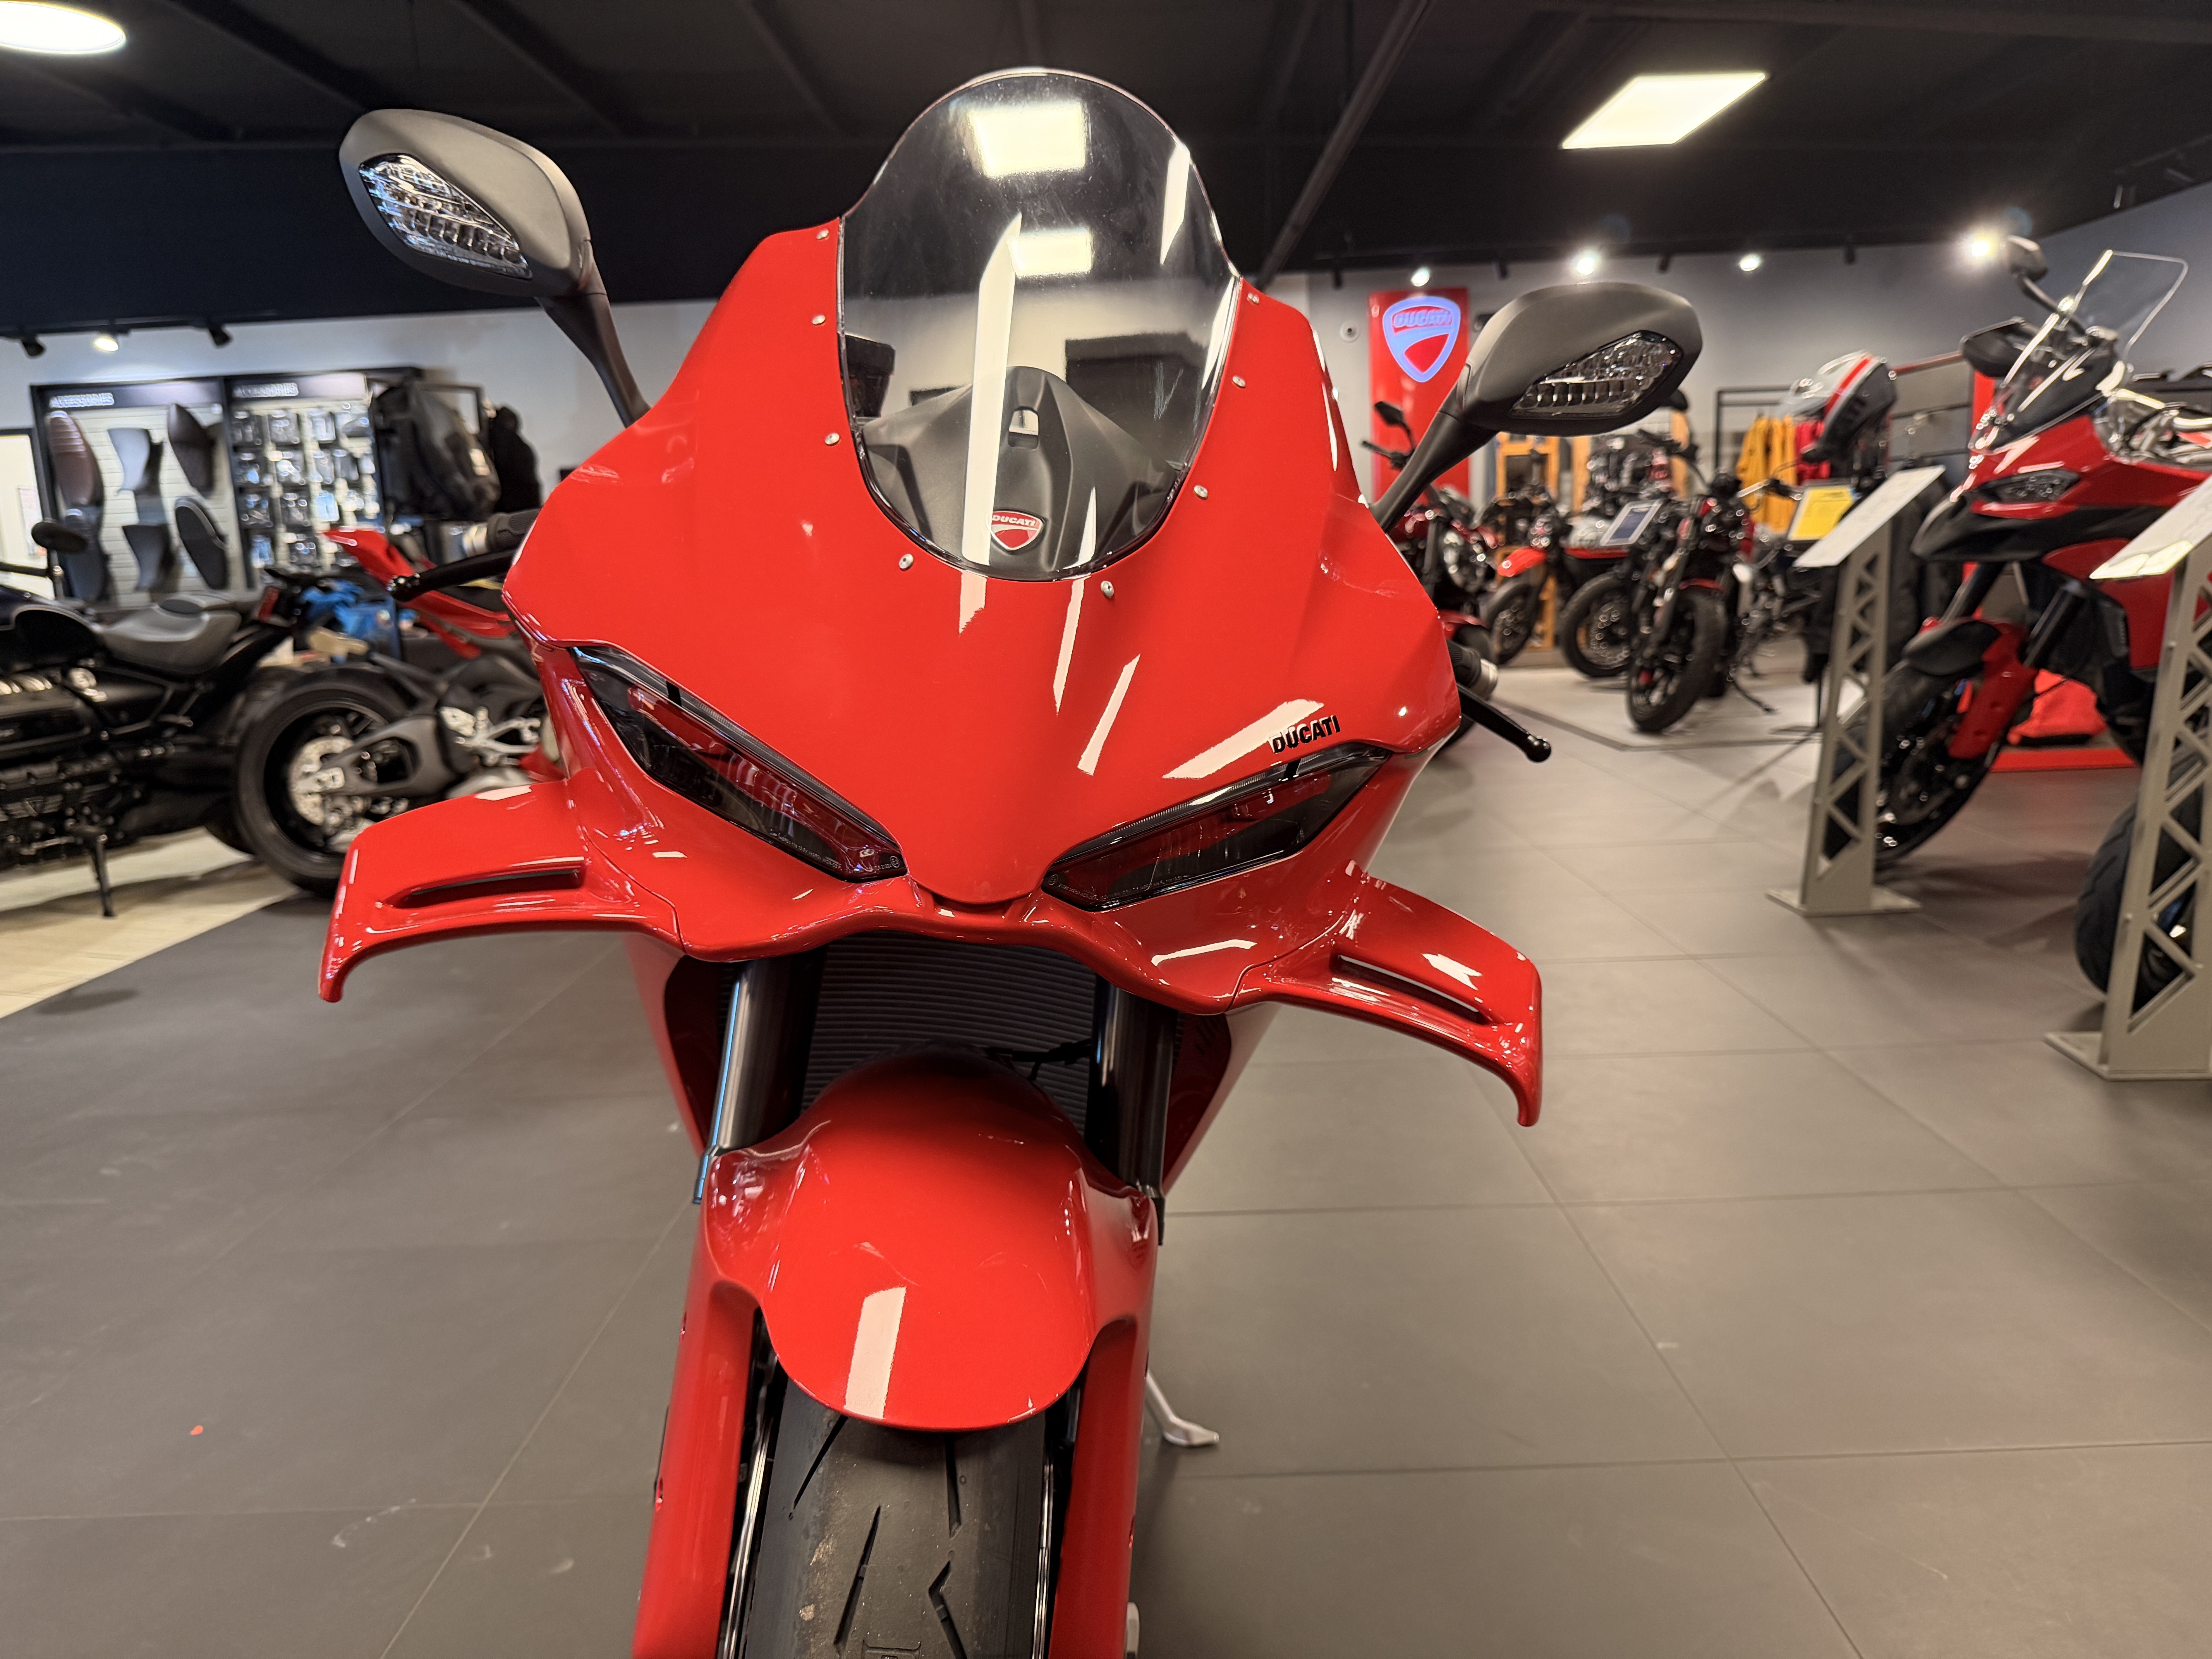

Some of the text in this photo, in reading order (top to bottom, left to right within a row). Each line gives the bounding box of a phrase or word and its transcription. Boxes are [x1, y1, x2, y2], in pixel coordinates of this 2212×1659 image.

[1394, 310, 1452, 328] DUCATI
[992, 515, 1035, 526] DUCATI
[1270, 715, 1341, 754] DUCATI
